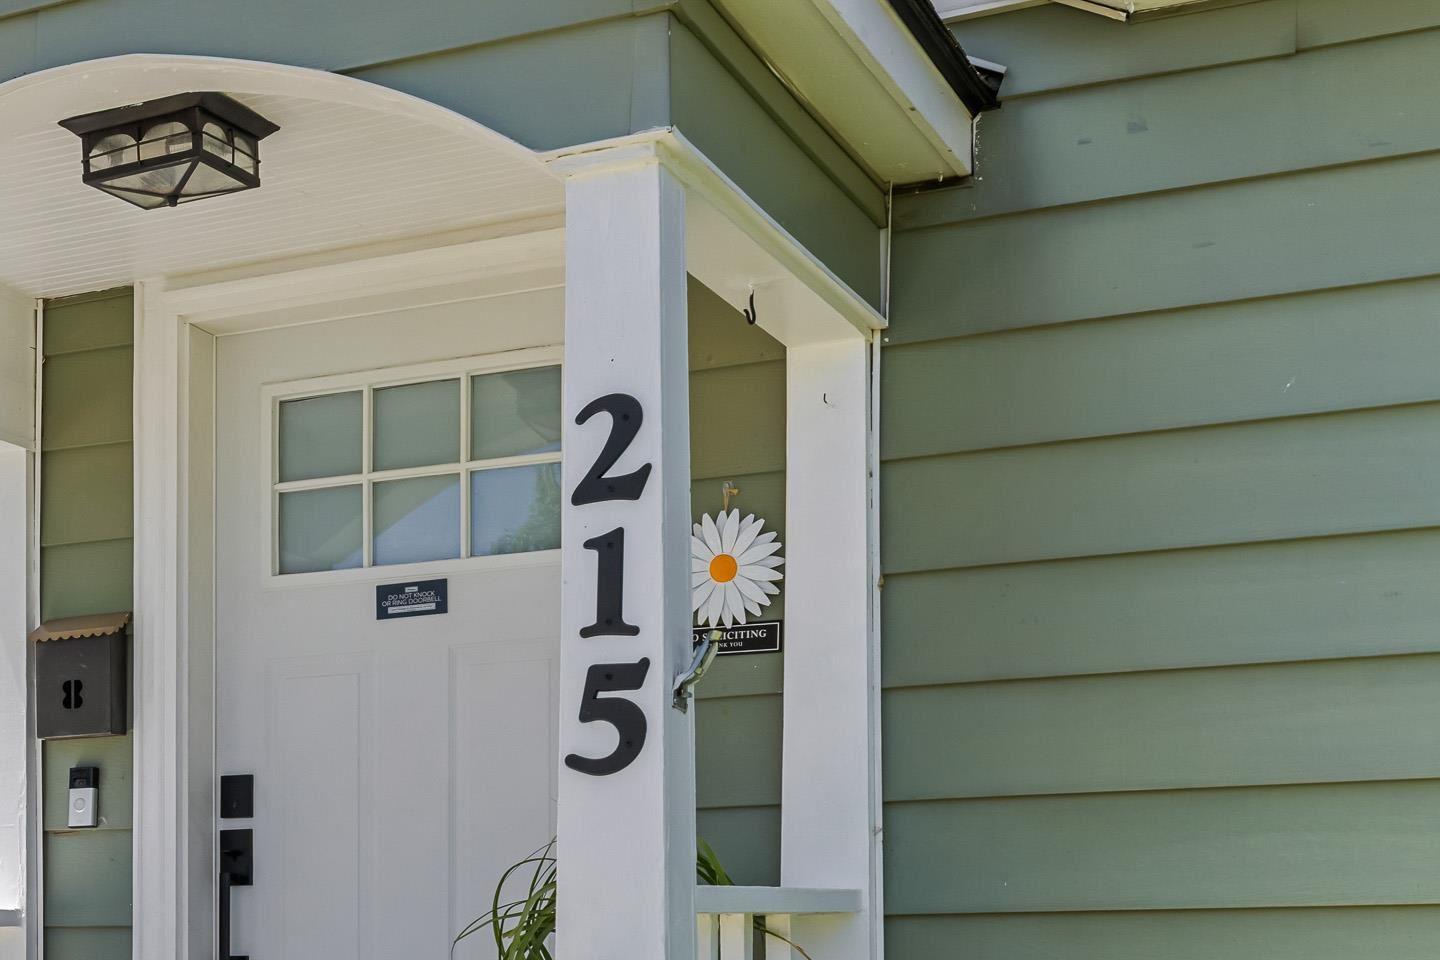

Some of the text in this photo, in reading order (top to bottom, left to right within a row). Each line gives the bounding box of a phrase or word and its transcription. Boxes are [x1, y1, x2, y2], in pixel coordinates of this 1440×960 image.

[564, 393, 652, 776] 215
[409, 596, 441, 604] DOORBELL
[702, 629, 767, 642] SICITING
